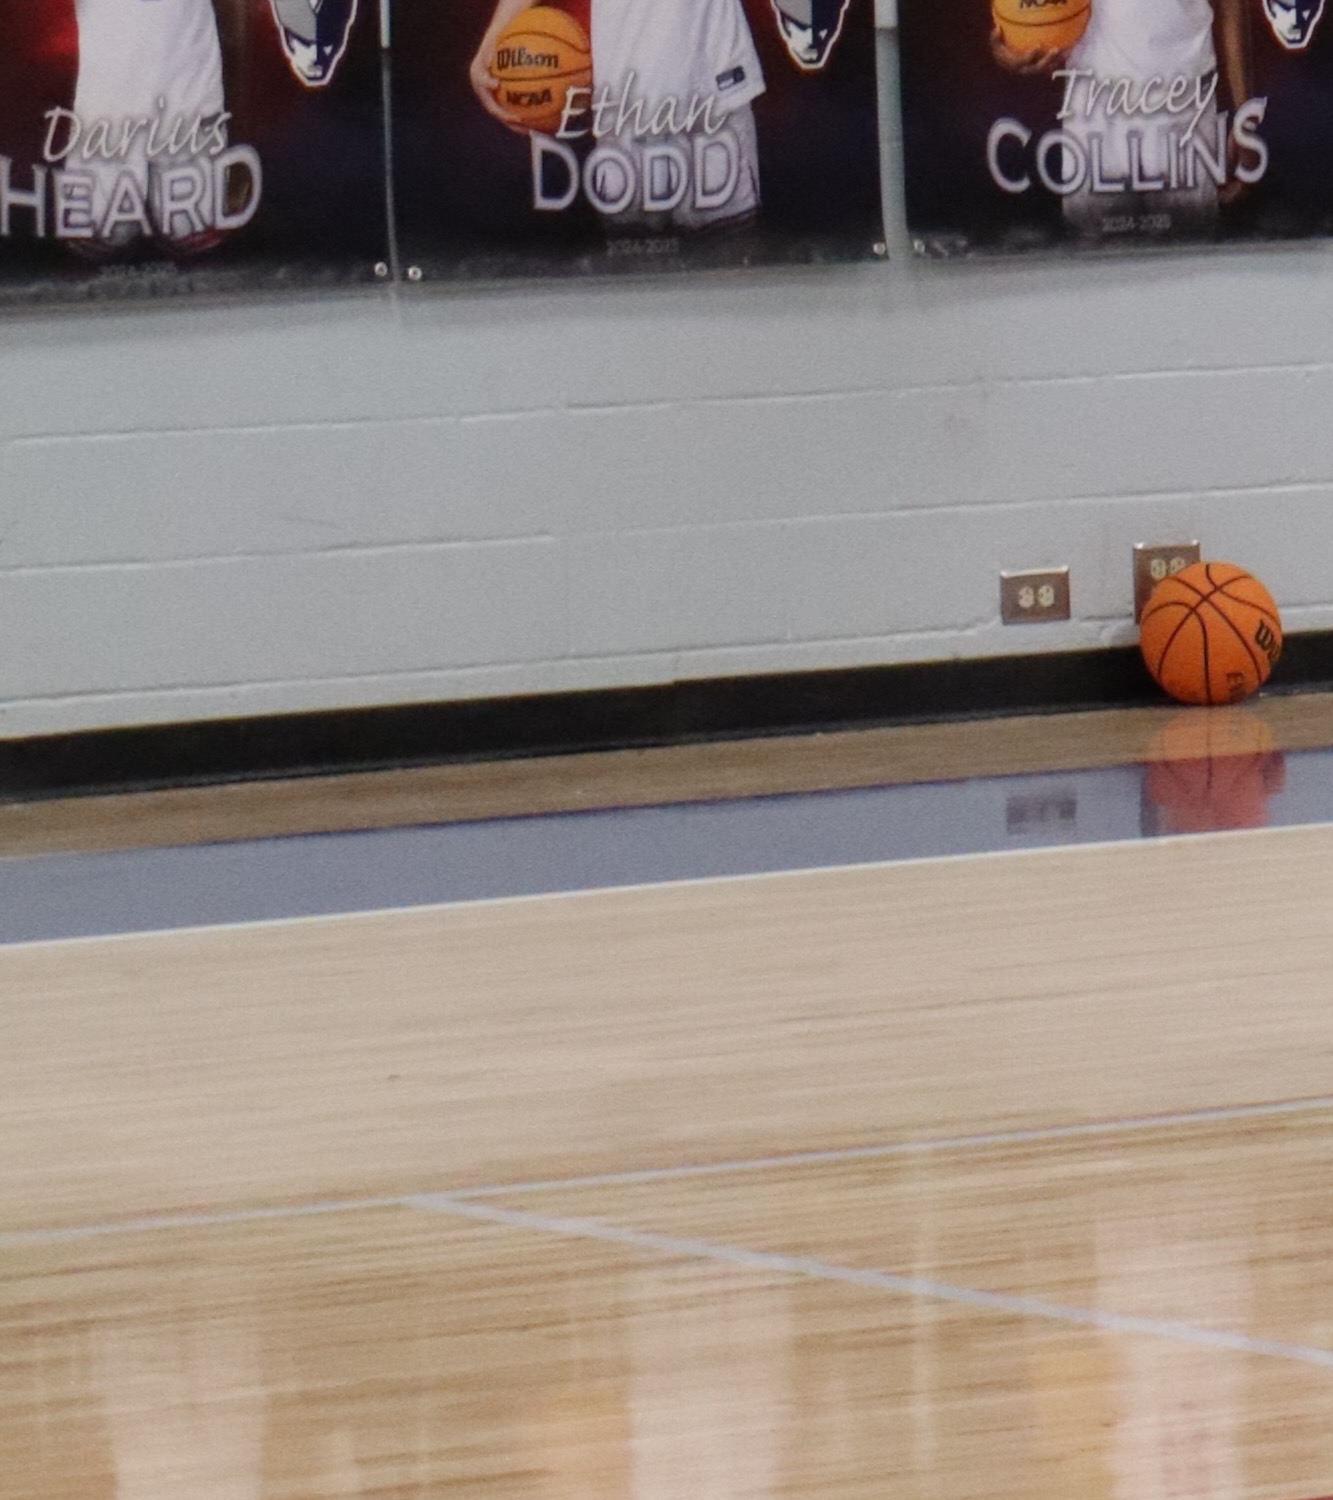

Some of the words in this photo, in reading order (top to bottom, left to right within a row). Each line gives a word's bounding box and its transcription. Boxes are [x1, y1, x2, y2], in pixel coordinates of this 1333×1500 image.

[497, 46, 559, 70] Wilson
[43, 95, 232, 162] Darius
[555, 70, 731, 139] Ethan
[1052, 68, 1218, 148] Tracey
[529, 128, 742, 214] DODD
[986, 96, 1269, 195] COLLINS
[0, 143, 262, 239] HEARD
